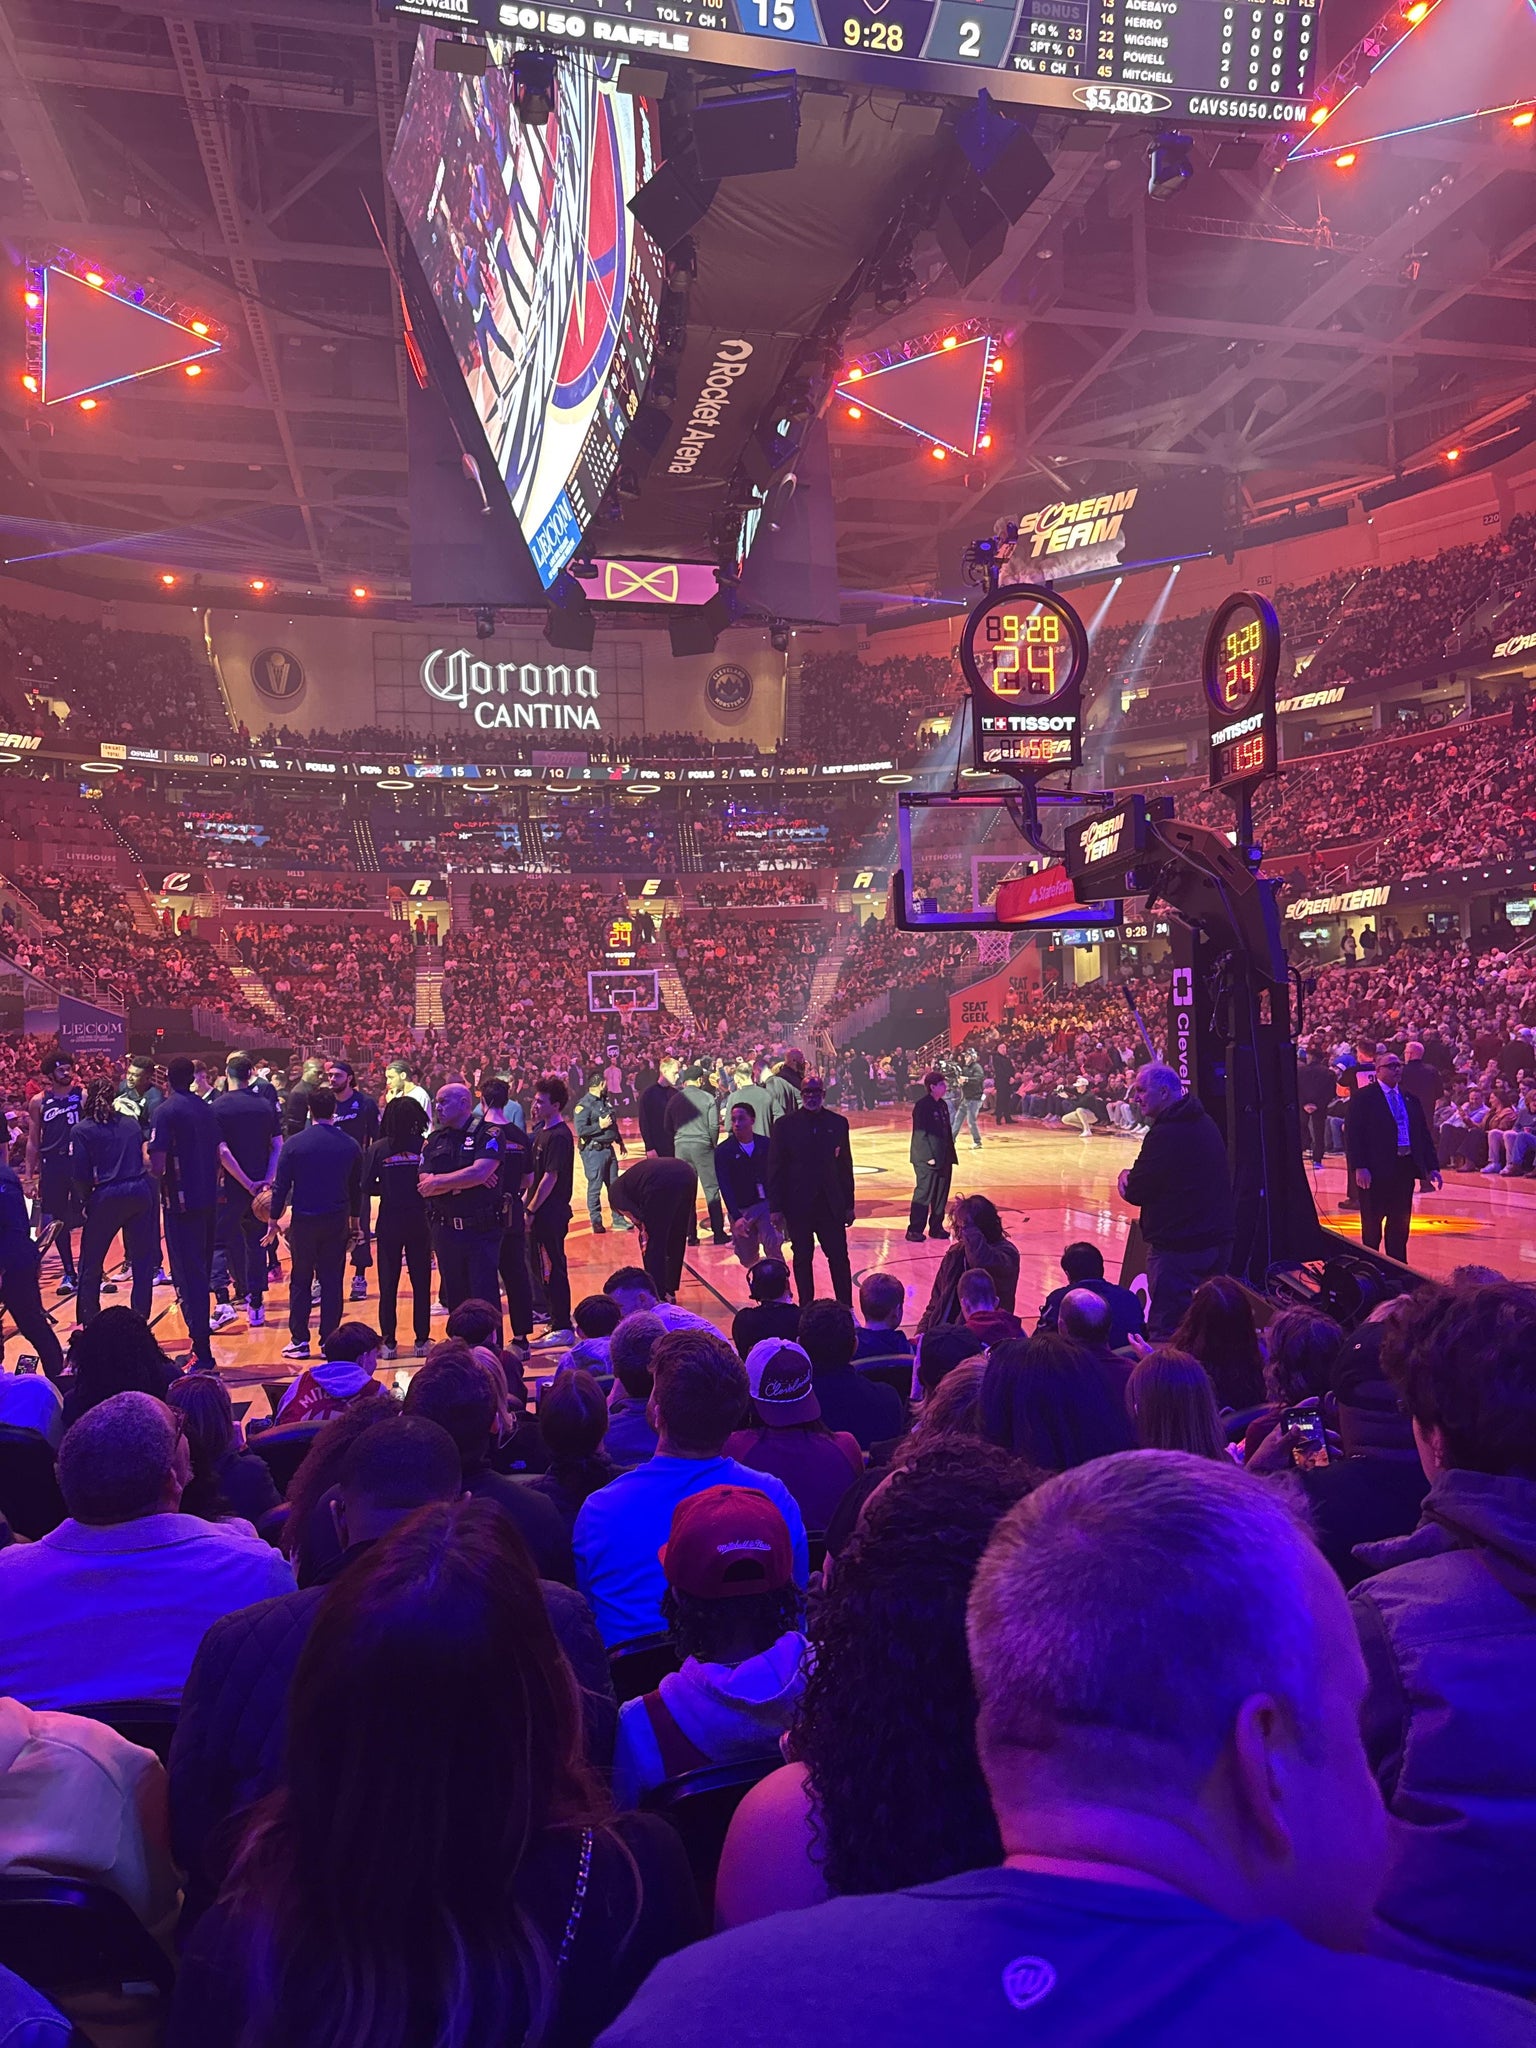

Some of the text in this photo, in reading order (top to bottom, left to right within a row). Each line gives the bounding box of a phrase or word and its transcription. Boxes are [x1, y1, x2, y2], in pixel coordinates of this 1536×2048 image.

[404, 0, 469, 13] swald
[754, 0, 795, 31] 15
[1032, 1, 1080, 19] BONUS
[1125, 0, 1177, 14] ADEBAYO
[1224, 7, 1233, 20] 0
[1252, 10, 1262, 23] 0
[1274, 12, 1284, 25] 0
[1301, 14, 1311, 27] 0
[657, 7, 727, 29] TOL 7 CH 1
[593, 20, 689, 52] RAFFLE
[843, 19, 903, 51] 9:28
[1031, 23, 1082, 41] FG % 33
[1100, 13, 1309, 44] 14 HERRO 0 0 0 0
[958, 21, 981, 57] 2
[1099, 31, 1308, 61] 22 WIGGINS 0 0 0 0
[1030, 41, 1075, 58] 3PT % 0
[1014, 57, 1080, 76] TOL 6 CH 1
[1097, 48, 1305, 78] 24 POWELL 2 0 0 1
[1097, 65, 1304, 95] 45 MITCHELL 0 0 0 1
[1086, 87, 1153, 114] $5,803
[1189, 97, 1307, 122] CAVS5050.COM
[668, 361, 747, 474] Rocket Arena
[1017, 488, 1138, 536] SCREAM
[1483, 514, 1499, 525] 220
[1030, 514, 1124, 558] TEAM
[1003, 615, 1059, 642] 9:28
[1227, 620, 1261, 662] 9:28
[420, 648, 600, 709] Corona
[992, 645, 1055, 695] 24
[1225, 656, 1254, 703] 24
[474, 701, 601, 730] CANTINA
[1009, 716, 1076, 731] TISSOT
[1225, 713, 1264, 741] TISSOT
[285, 761, 293, 770] 7
[342, 765, 348, 774] 1
[387, 766, 401, 775] 83
[451, 766, 464, 777] 15
[486, 768, 496, 776] 24
[549, 769, 564, 778] 1Q
[583, 769, 591, 778] 2
[721, 770, 728, 779] 2
[762, 768, 769, 778] 6
[797, 767, 808, 775] PM
[664, 771, 676, 780] 33
[1080, 812, 1125, 847] SCREAM
[66, 853, 116, 862] LITEHOUSE
[1084, 833, 1120, 864] TEAM
[410, 880, 432, 895] R
[641, 879, 661, 895] E
[853, 872, 873, 888] A
[609, 931, 631, 947] 24
[1085, 929, 1099, 942] 15
[1126, 926, 1147, 938] 9:28
[1009, 976, 1028, 990] SEAT
[962, 1001, 987, 1012] SEAT
[961, 1012, 989, 1023] GEEK
[1177, 1013, 1191, 1097] Clevela
[67, 1111, 79, 1124] 31
